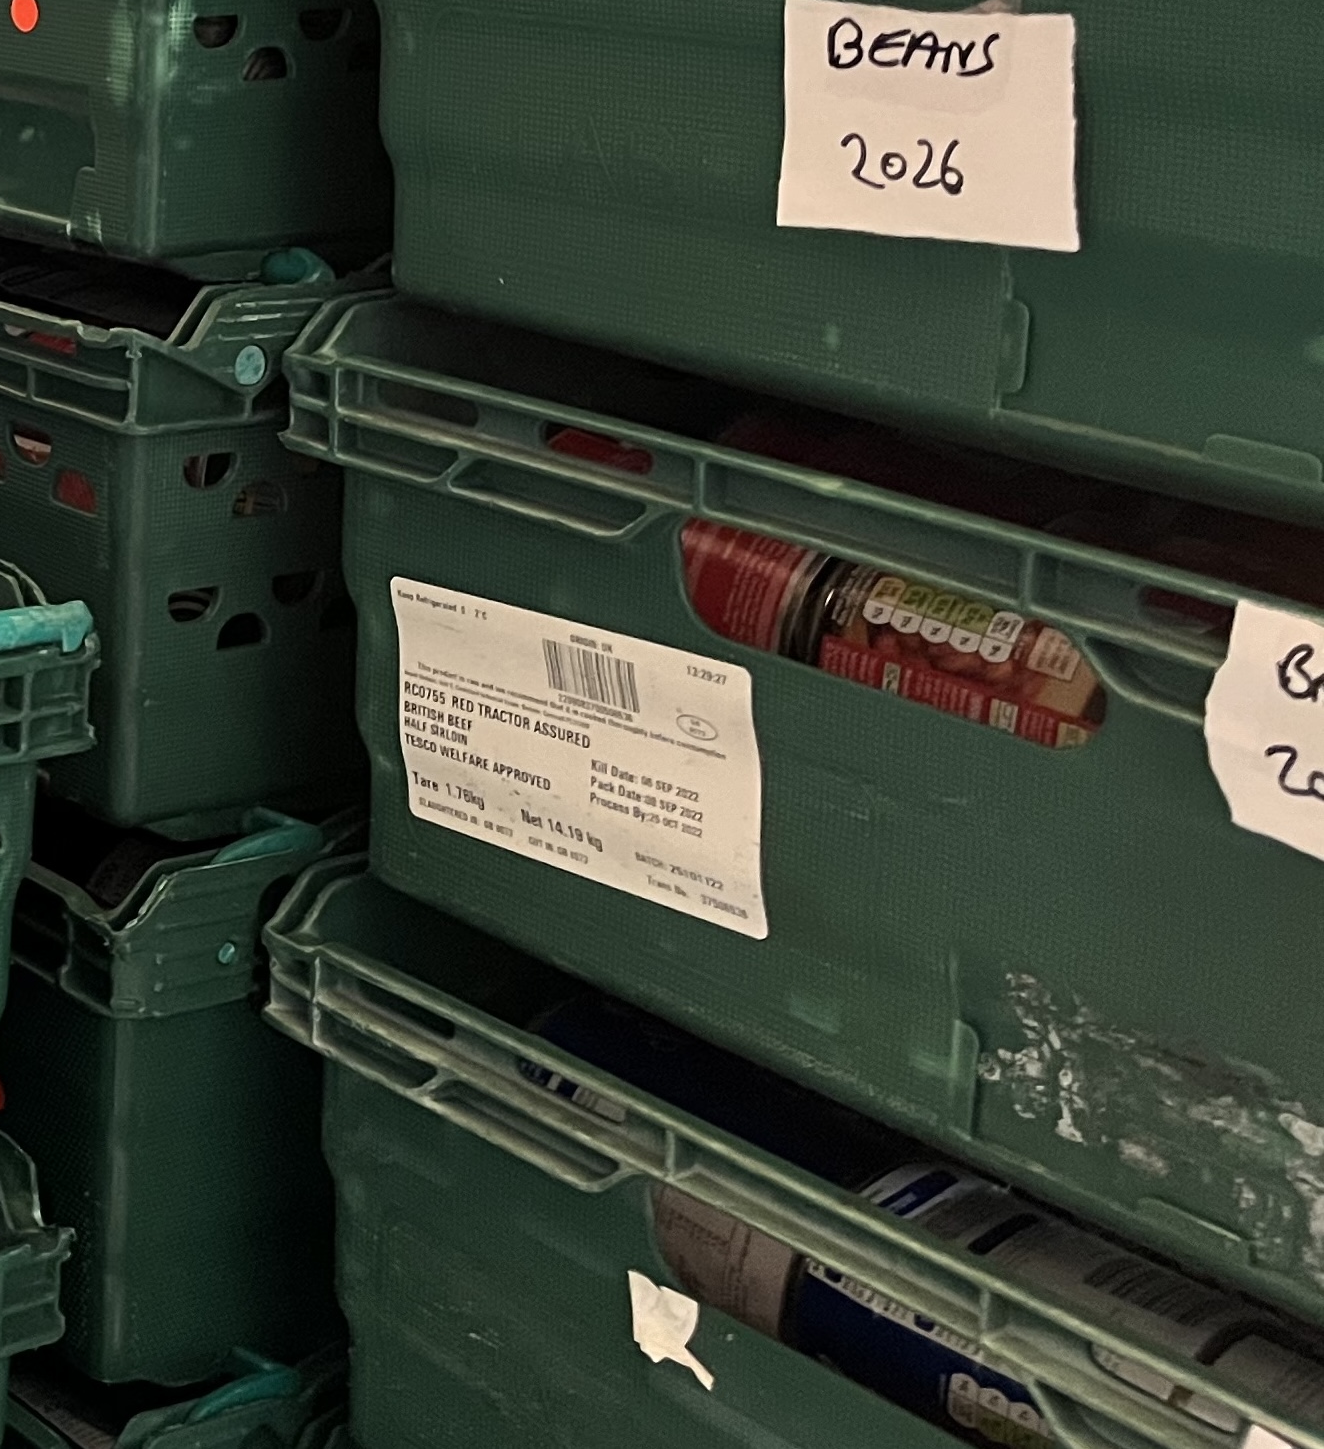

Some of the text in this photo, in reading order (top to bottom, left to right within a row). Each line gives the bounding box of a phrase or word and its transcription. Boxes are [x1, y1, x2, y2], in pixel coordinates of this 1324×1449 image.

[826, 16, 1001, 77] BEANS
[840, 132, 965, 196] 2026
[1277, 643, 1324, 702] B
[404, 700, 473, 732] BRITISH BEEF
[404, 716, 468, 746] HALF SIRLOIN
[451, 695, 474, 714] RED
[477, 702, 530, 731] TRACTOR
[533, 720, 591, 749] ASSURED
[404, 732, 551, 791] TESCO WELFARE APPROVED
[412, 770, 439, 793] Tare
[589, 792, 630, 815] Process
[590, 775, 615, 794] Pack
[659, 799, 677, 814] SEP
[680, 805, 704, 823] 2022
[655, 779, 673, 793] SEP
[676, 786, 699, 803] 2022
[521, 807, 543, 829] Net
[585, 831, 603, 853] kg
